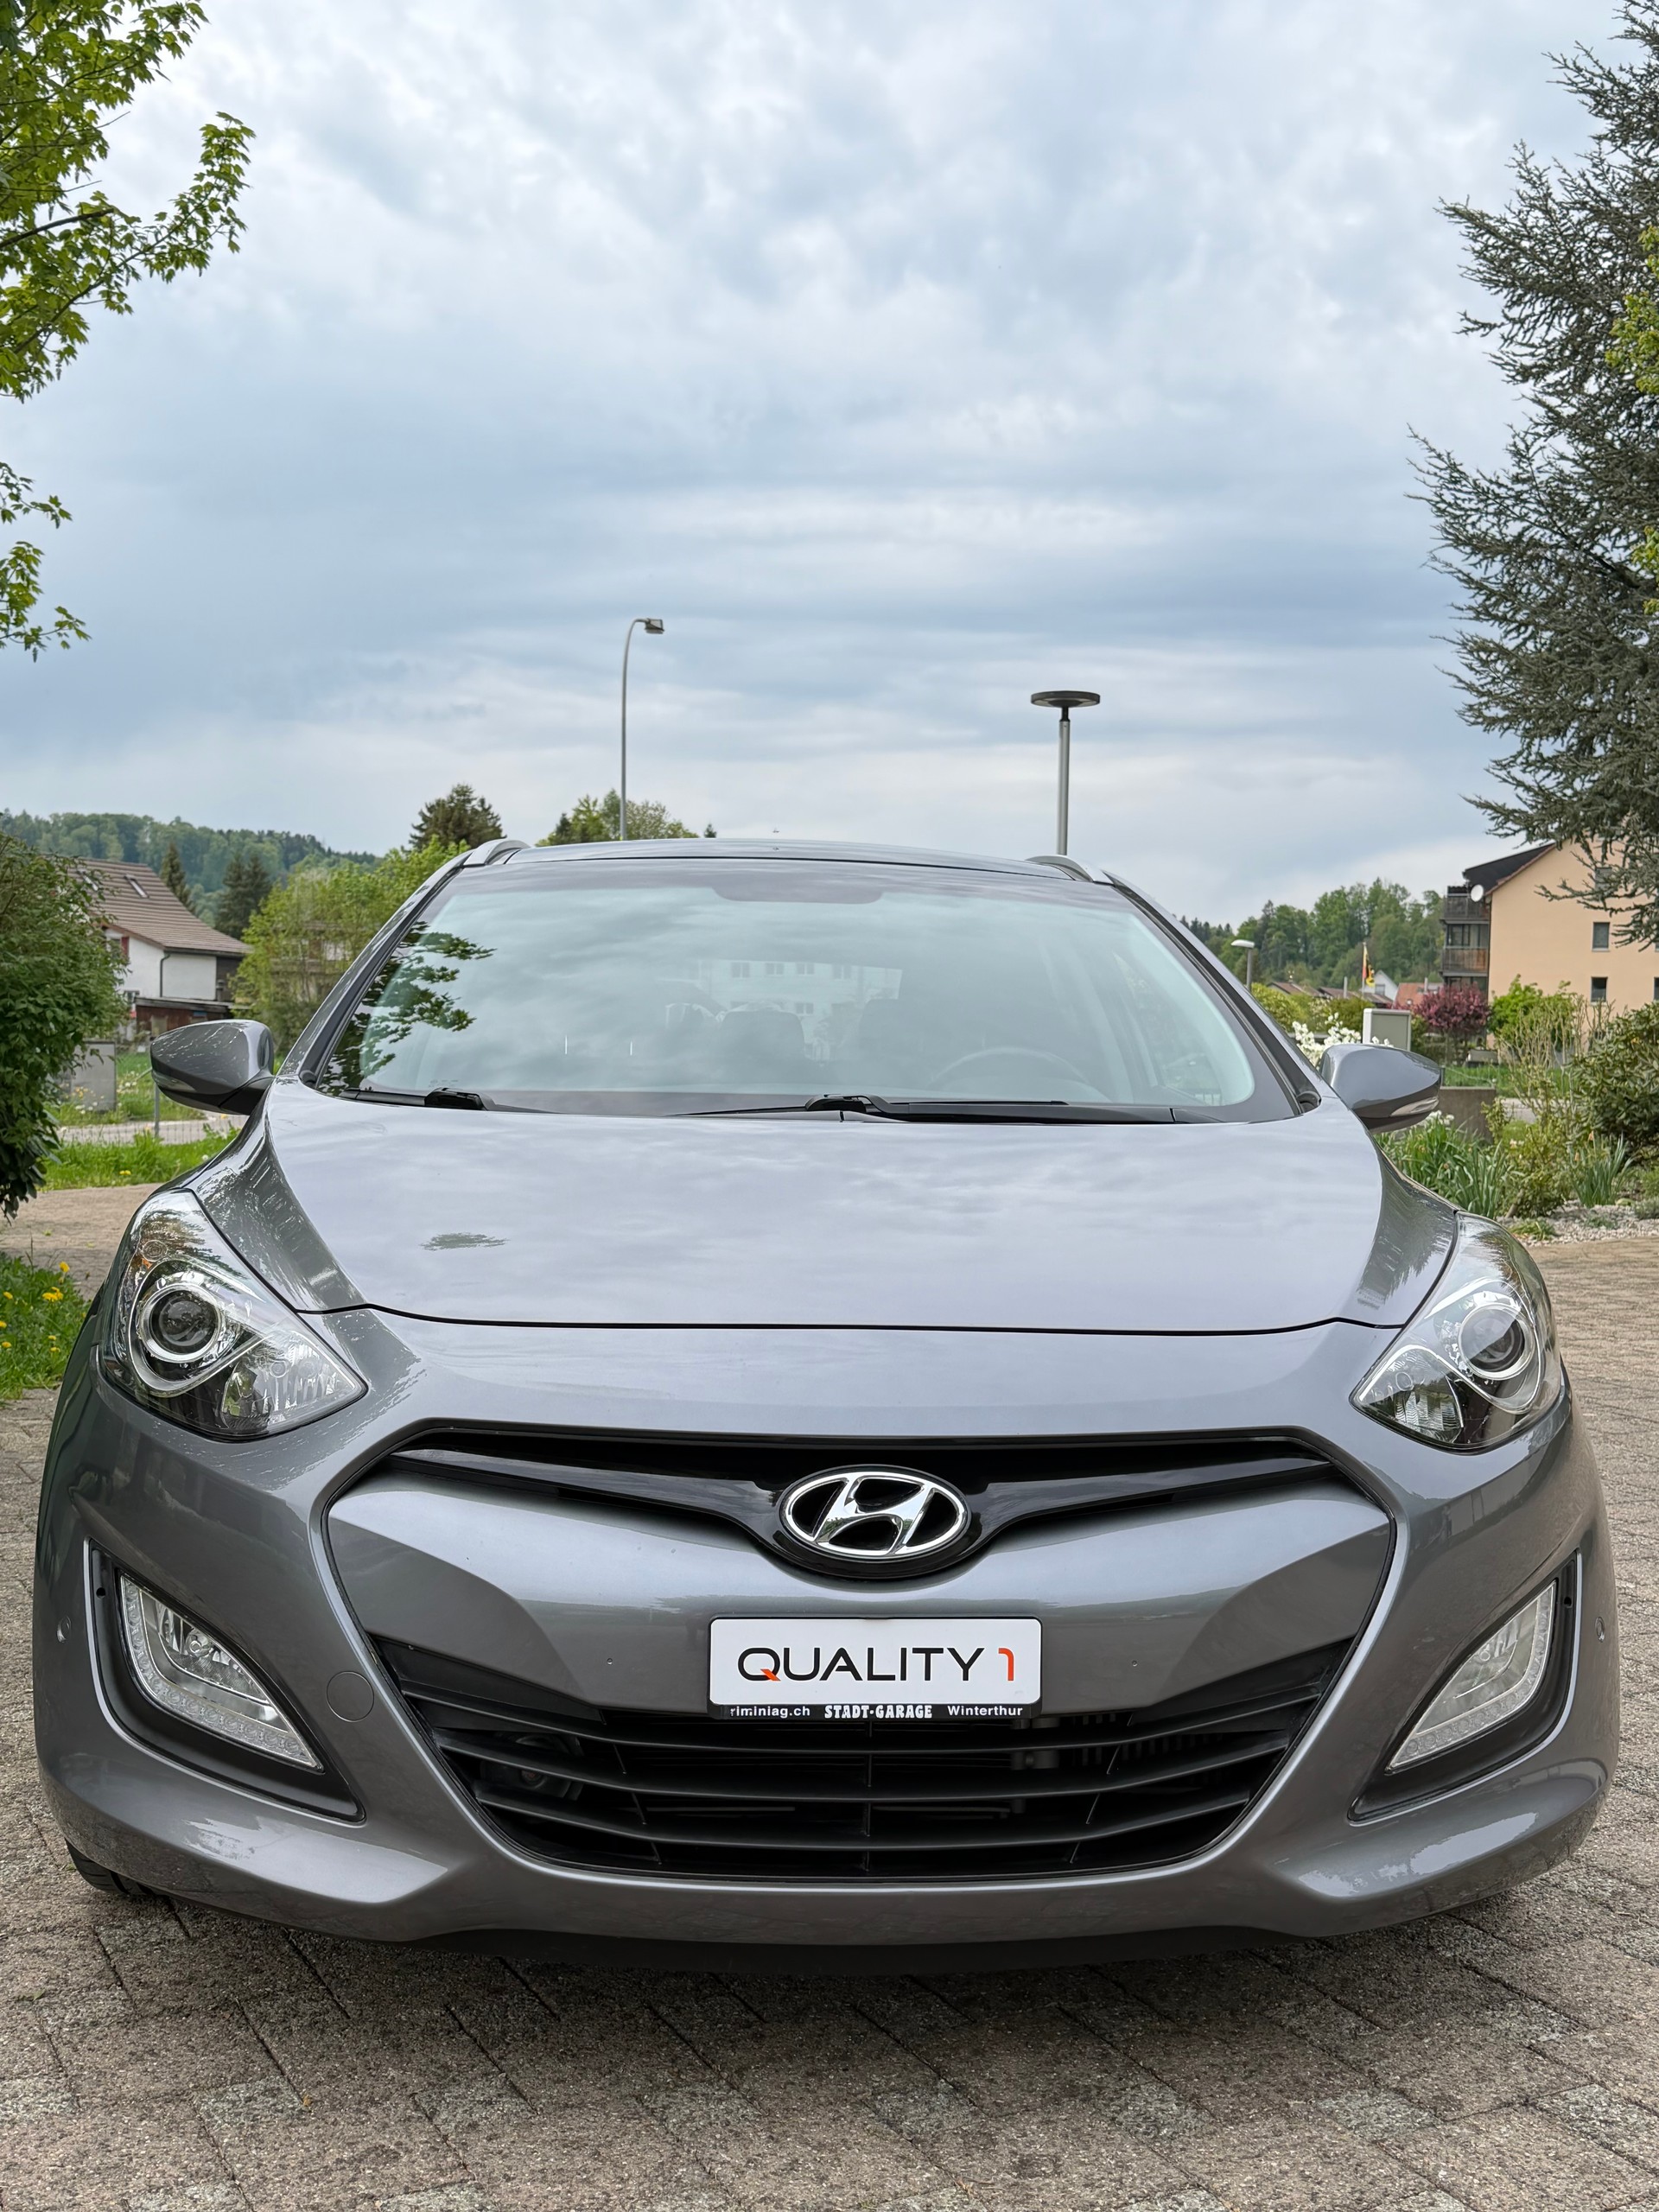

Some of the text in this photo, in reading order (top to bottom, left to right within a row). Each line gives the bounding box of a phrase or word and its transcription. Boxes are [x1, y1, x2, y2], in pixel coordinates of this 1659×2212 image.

[737, 1647, 1014, 1681] QUALITY 1
[947, 1705, 1023, 1716] Winterthur
